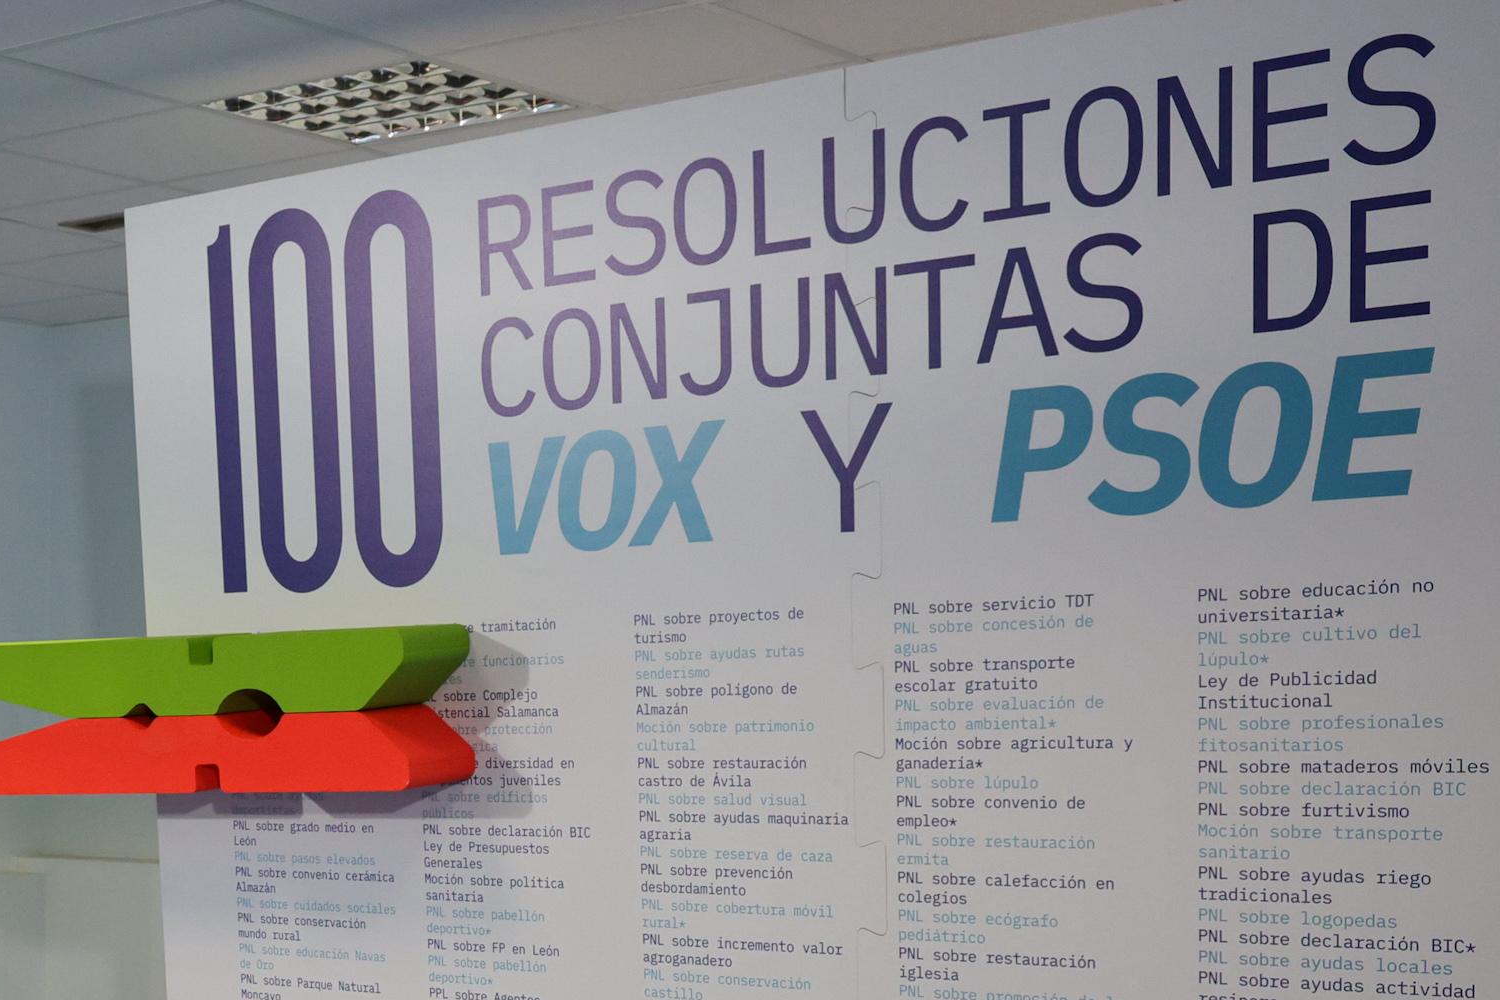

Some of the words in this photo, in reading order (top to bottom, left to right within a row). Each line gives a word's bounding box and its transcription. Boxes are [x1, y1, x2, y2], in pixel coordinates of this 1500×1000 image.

[478, 33, 1438, 297] RESOLUCIONES
[480, 232, 1144, 418] CONJUNTAS
[1252, 190, 1432, 335] DE
[206, 189, 443, 594] 100
[487, 419, 725, 557] VOX
[800, 402, 893, 534] Y
[990, 346, 1437, 525] PSOE
[1197, 587, 1228, 603] PNL
[1239, 585, 1291, 601] sobre
[1301, 578, 1400, 598] educación
[1412, 581, 1434, 593] no
[893, 602, 920, 616] PNL
[928, 599, 973, 615] sobre
[982, 595, 1056, 612] servicio
[1064, 593, 1095, 608] TDT
[633, 613, 656, 627] PNL
[663, 611, 702, 626] sobre
[708, 608, 780, 626] proyectos
[787, 606, 805, 620] de
[633, 630, 687, 645] turismo
[894, 660, 921, 673] PNL
[929, 658, 974, 673] sobre
[982, 655, 1076, 673] transporte
[894, 678, 956, 693] escolar
[964, 676, 1038, 695] gratuito
[1198, 674, 1228, 692] Ley
[1238, 672, 1259, 688] de
[1270, 669, 1377, 687] Publicidad
[1198, 692, 1333, 710] Institucional
[895, 736, 948, 751] Moción
[956, 736, 1002, 750] sobre
[1010, 735, 1114, 754] agricultura
[1123, 738, 1133, 753] y
[637, 756, 660, 769] PNL
[667, 756, 705, 770] sobre
[712, 755, 807, 770] restauración
[1198, 759, 1229, 774] PNL
[1238, 759, 1291, 774] sobre
[1300, 759, 1399, 774] mataderos
[1410, 758, 1490, 774] móviles
[638, 775, 683, 787] castro
[689, 774, 706, 788] de
[712, 771, 752, 788] Ávila
[1198, 802, 1228, 816] PNL
[1239, 802, 1291, 817] sobre
[1301, 802, 1410, 819] furtivismo
[232, 820, 251, 831] PNL
[255, 822, 285, 832] sobre
[289, 821, 320, 835] grado
[324, 822, 356, 834] medio
[361, 824, 375, 834] en
[422, 823, 442, 836] PNL
[448, 823, 482, 837] sobre
[569, 826, 591, 839] BIC
[423, 839, 443, 855] Ley
[448, 840, 463, 853] de
[468, 840, 550, 856] Presupuestos
[423, 856, 483, 870] Generales
[235, 865, 253, 878] PNL
[257, 867, 287, 879] sobre
[292, 868, 340, 881] convenio
[897, 870, 924, 885] PNL
[932, 872, 976, 886] sobre
[985, 873, 1086, 889] calefacción
[1095, 879, 1115, 891] en
[897, 889, 968, 908] colegios
[240, 973, 258, 985] PNL
[262, 975, 292, 988] sobre
[296, 977, 333, 992] Parque
[338, 980, 381, 994] Natural
[428, 987, 449, 1000] PPL
